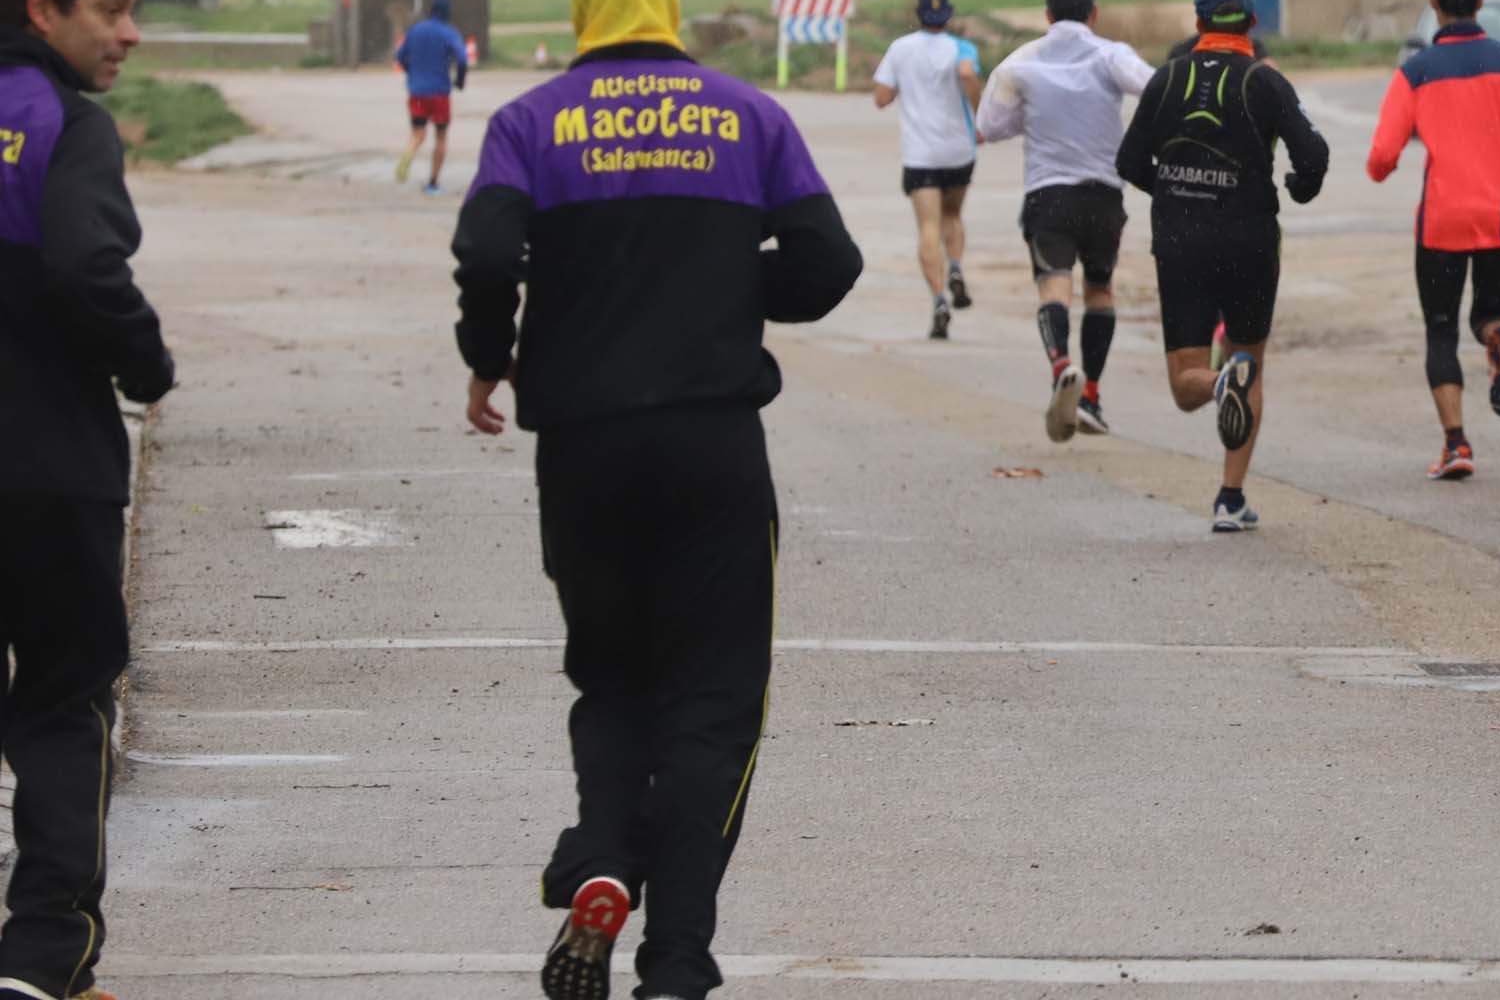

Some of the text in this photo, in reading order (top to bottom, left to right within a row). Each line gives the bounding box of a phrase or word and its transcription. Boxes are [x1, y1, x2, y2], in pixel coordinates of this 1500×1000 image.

[590, 74, 703, 99] Atletismo
[554, 96, 740, 146] Macotera
[581, 145, 715, 174] (Salamanca)
